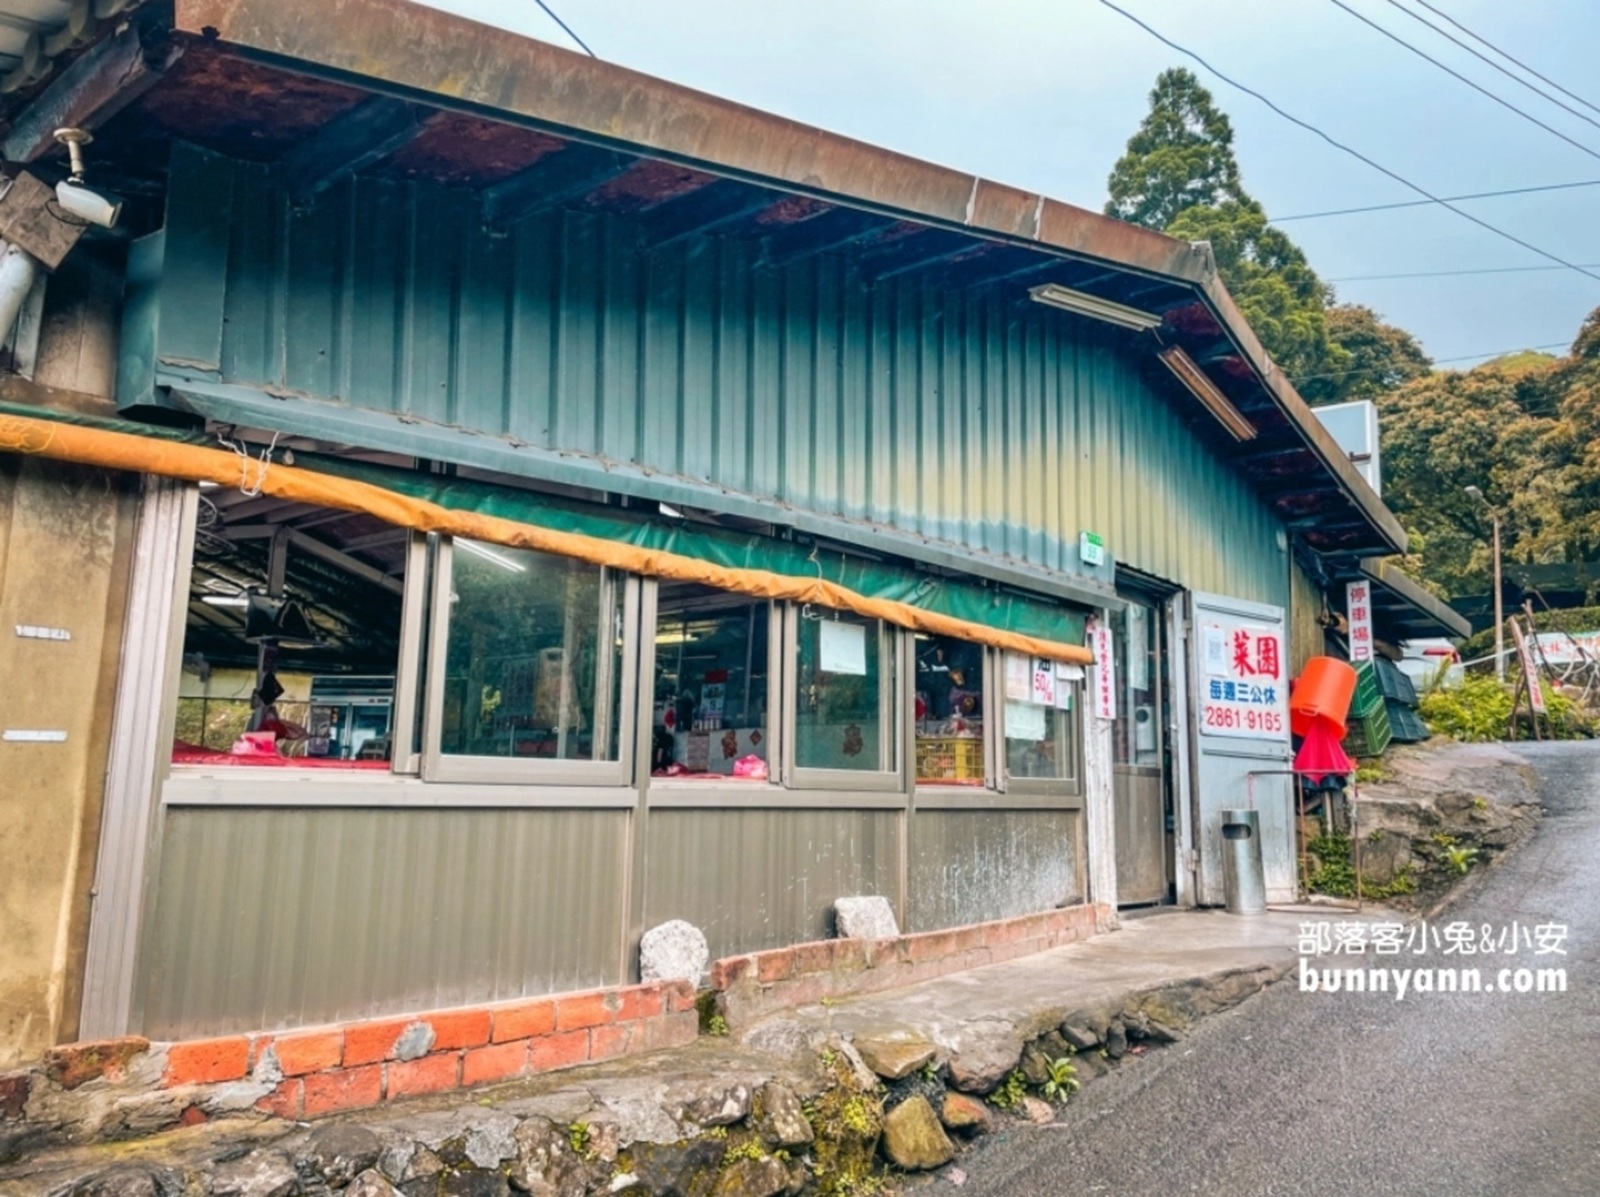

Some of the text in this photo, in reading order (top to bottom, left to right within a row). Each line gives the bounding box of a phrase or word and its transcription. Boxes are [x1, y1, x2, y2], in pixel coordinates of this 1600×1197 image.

[1233, 630, 1280, 680] 菜園
[1209, 679, 1276, 706] 每週三公休
[1206, 706, 1282, 732] 2861-9165
